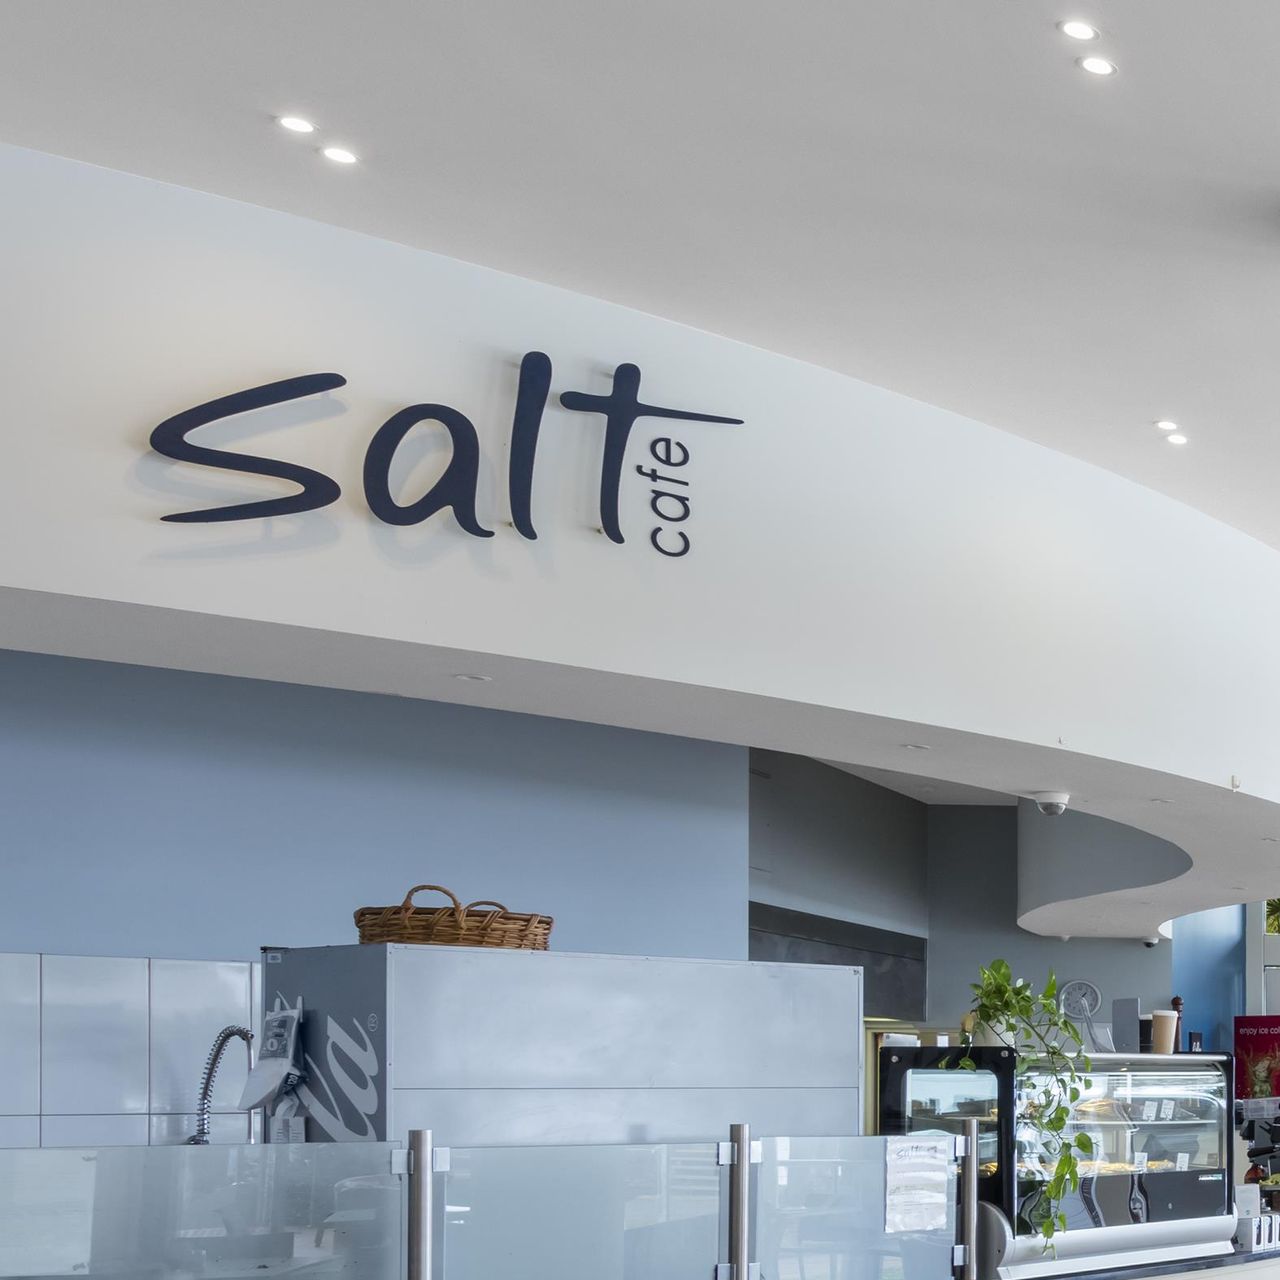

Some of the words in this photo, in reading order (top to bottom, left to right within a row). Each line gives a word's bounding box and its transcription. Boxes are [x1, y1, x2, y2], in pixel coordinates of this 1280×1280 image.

[150, 351, 744, 545] salt
[650, 436, 690, 558] cafe
[1239, 1027, 1258, 1036] enjoy
[1258, 1026, 1269, 1034] ice
